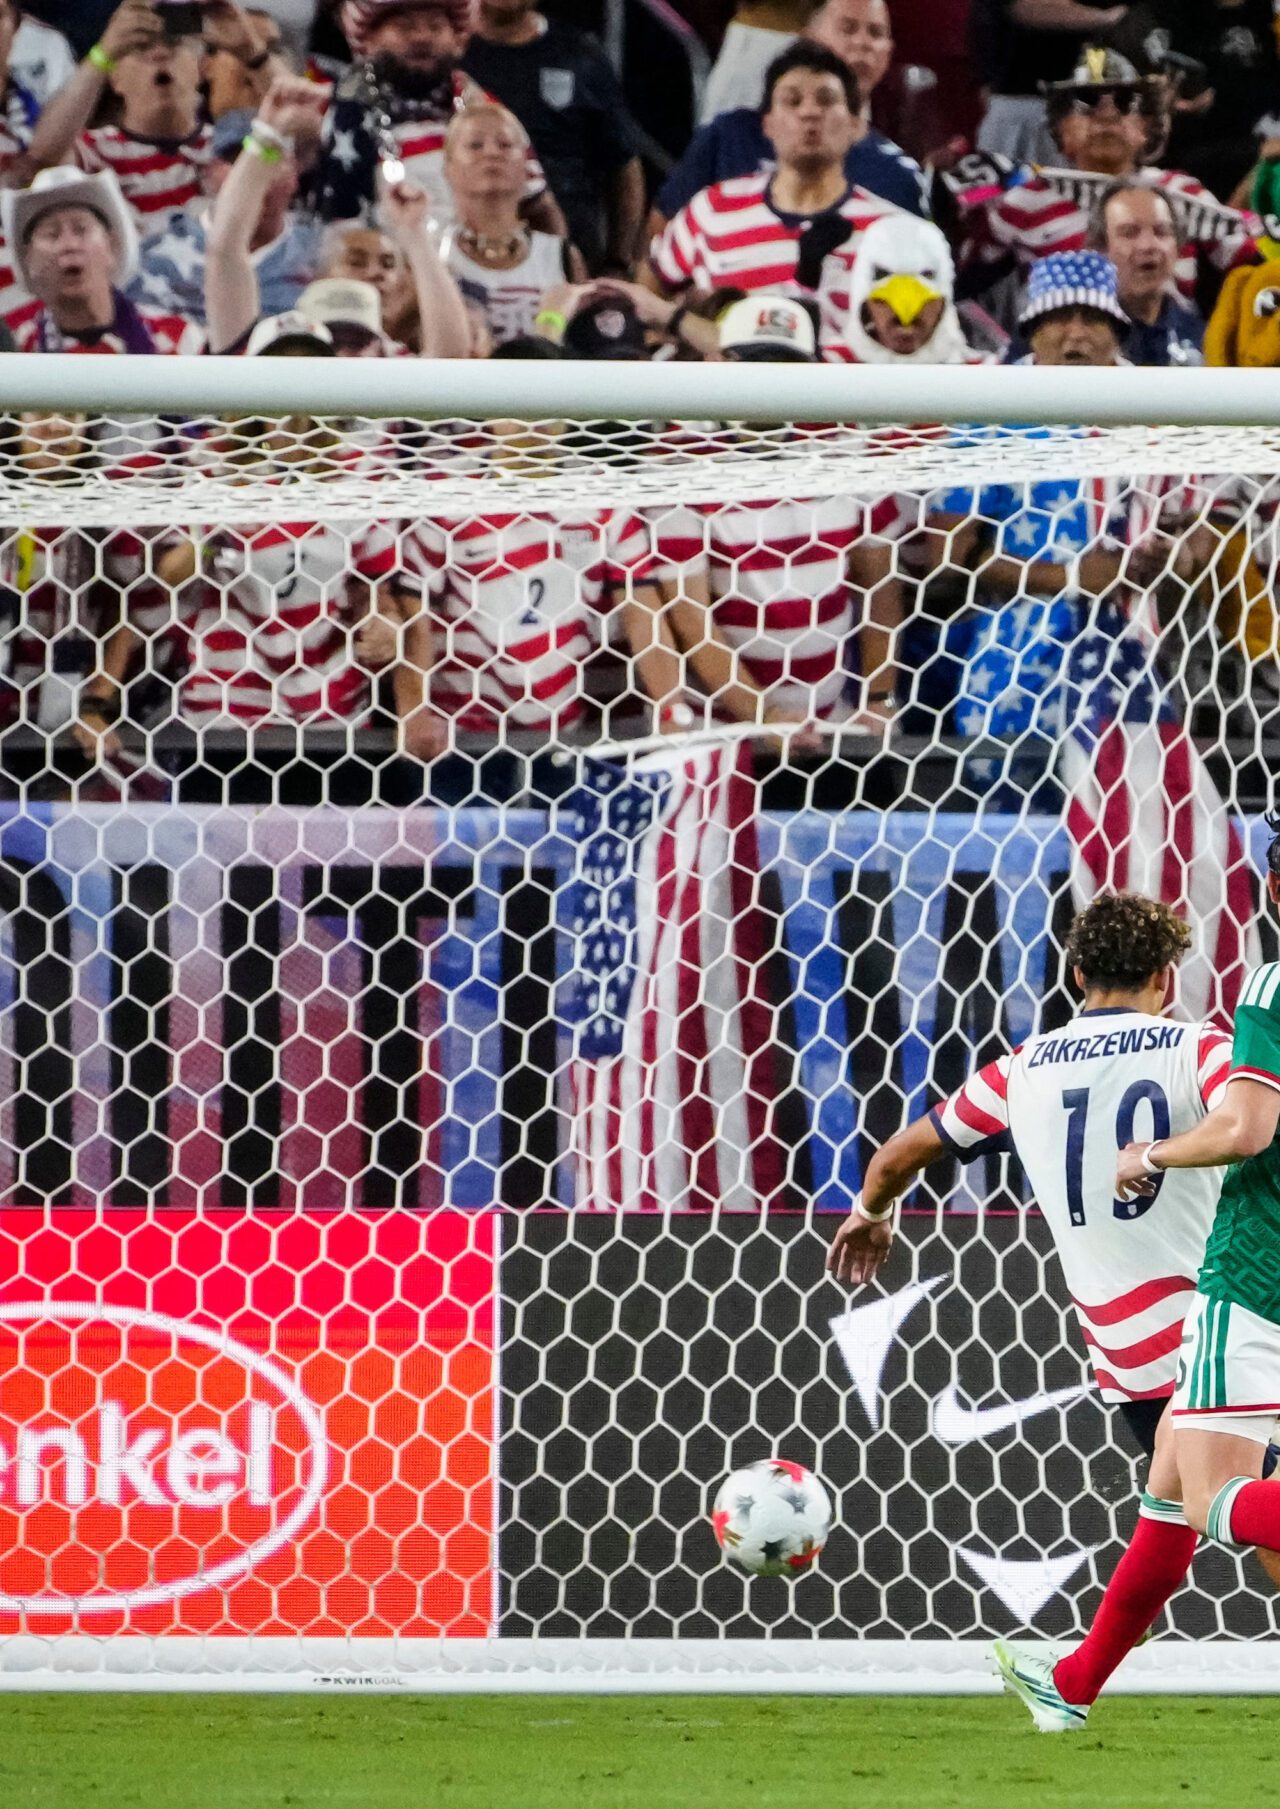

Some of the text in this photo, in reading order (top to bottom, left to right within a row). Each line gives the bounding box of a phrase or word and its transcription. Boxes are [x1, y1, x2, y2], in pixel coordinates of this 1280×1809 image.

[1027, 1026, 1185, 1069] ZAKRZEWSKI
[1061, 1078, 1171, 1228] 19
[0, 1398, 275, 1508] nkel
